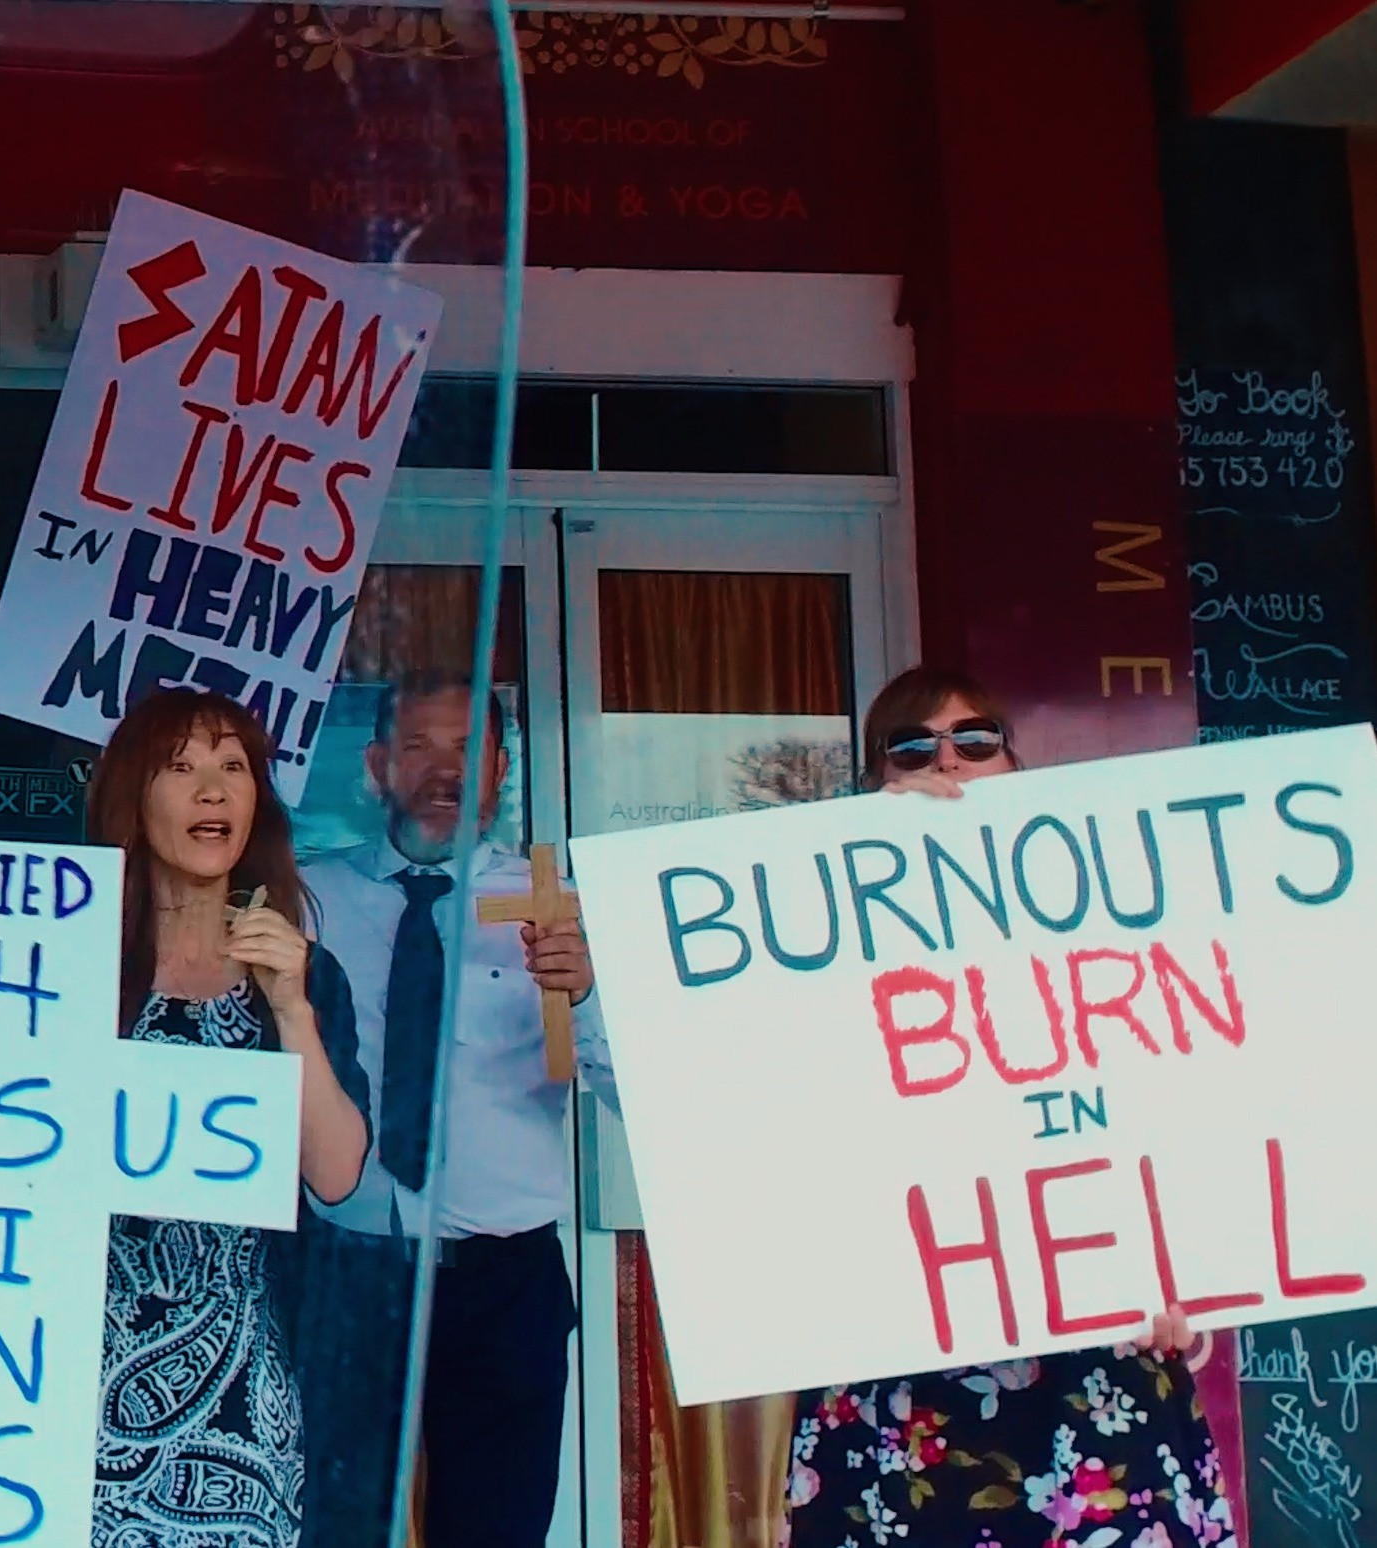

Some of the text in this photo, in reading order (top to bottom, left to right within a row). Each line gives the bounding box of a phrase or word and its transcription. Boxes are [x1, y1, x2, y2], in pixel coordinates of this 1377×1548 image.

[555, 116, 696, 145] SCHOOL
[707, 116, 753, 145] OF
[310, 182, 809, 219] MEDITATON & YOGA
[117, 240, 425, 440] SATAN
[1232, 370, 1345, 419] Book
[80, 380, 371, 574] LIVES
[1211, 456, 1269, 488] 753
[1277, 457, 1345, 490] 420
[34, 511, 356, 674] IN HEAVY
[29, 792, 75, 815] FX
[658, 782, 1355, 988] BURNOUTS
[871, 939, 1246, 1097] BURN
[1024, 1087, 1108, 1138] IN
[906, 1138, 1368, 1354] HELL
